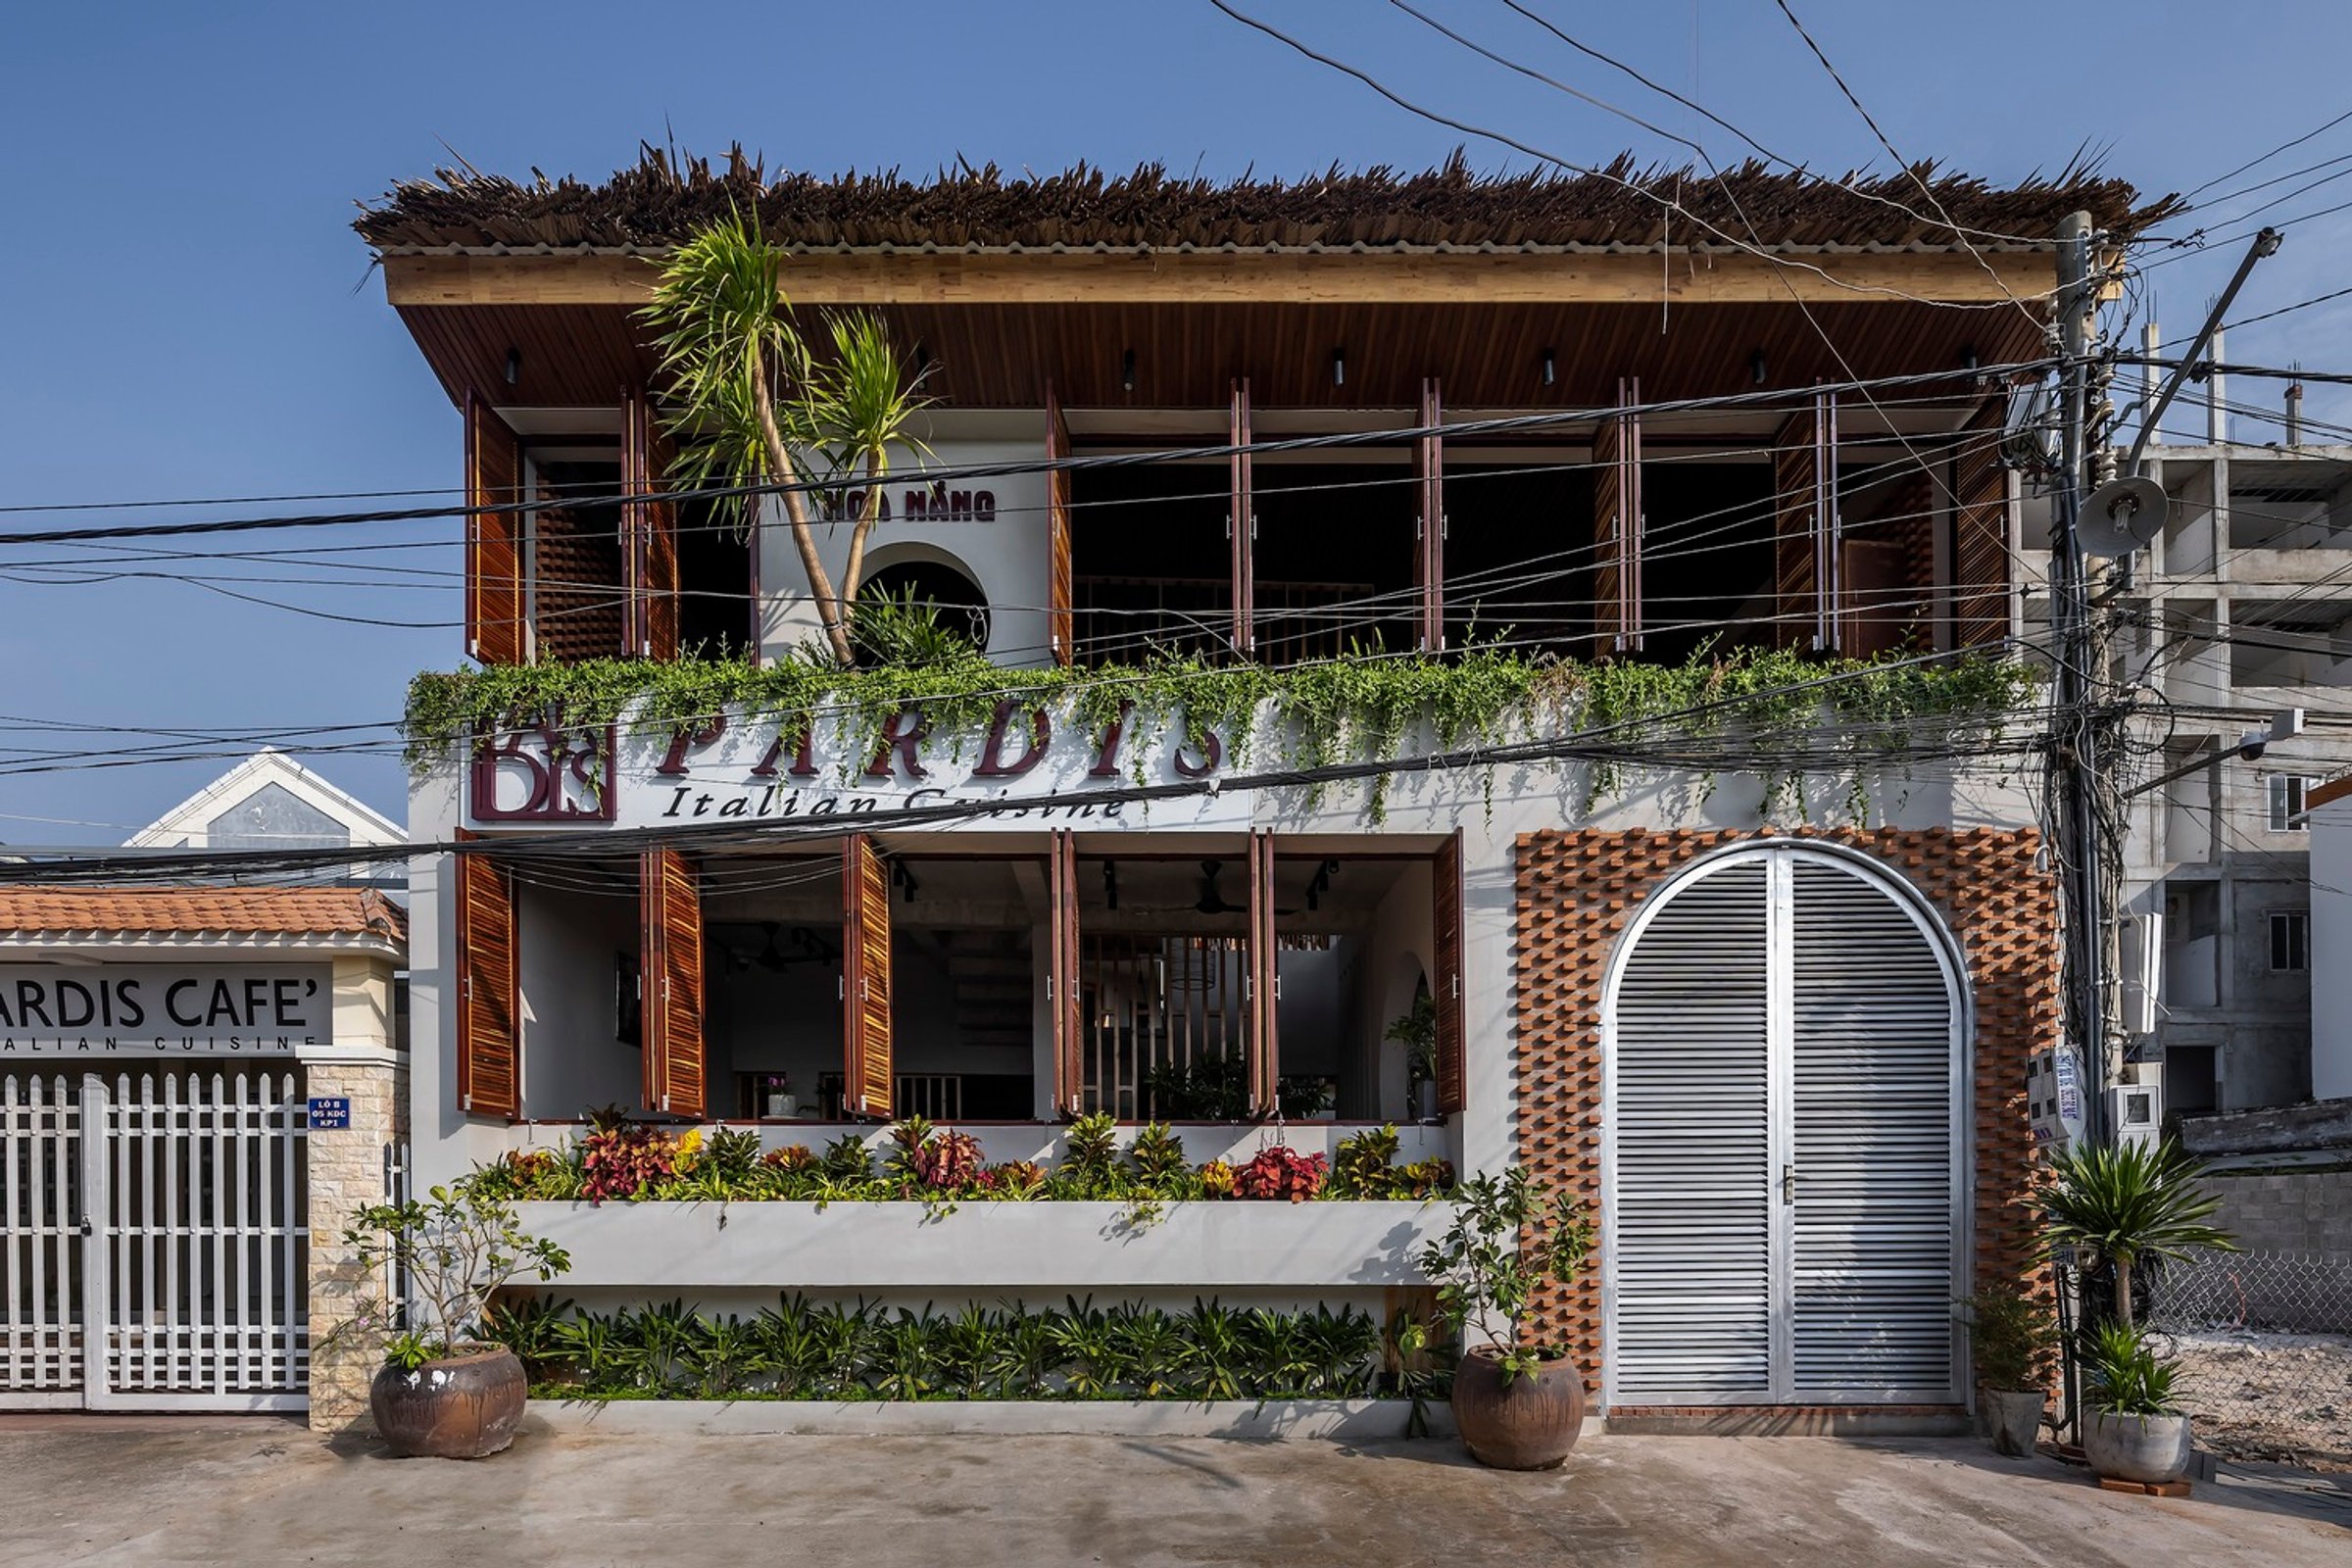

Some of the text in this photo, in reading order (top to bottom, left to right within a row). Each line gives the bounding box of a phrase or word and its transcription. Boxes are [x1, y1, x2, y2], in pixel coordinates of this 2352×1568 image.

[662, 786, 1126, 819] Italian Cisine
[165, 978, 318, 1028] CAFE'
[4, 1037, 117, 1051] ALIAN
[326, 1109, 347, 1118] KDC
